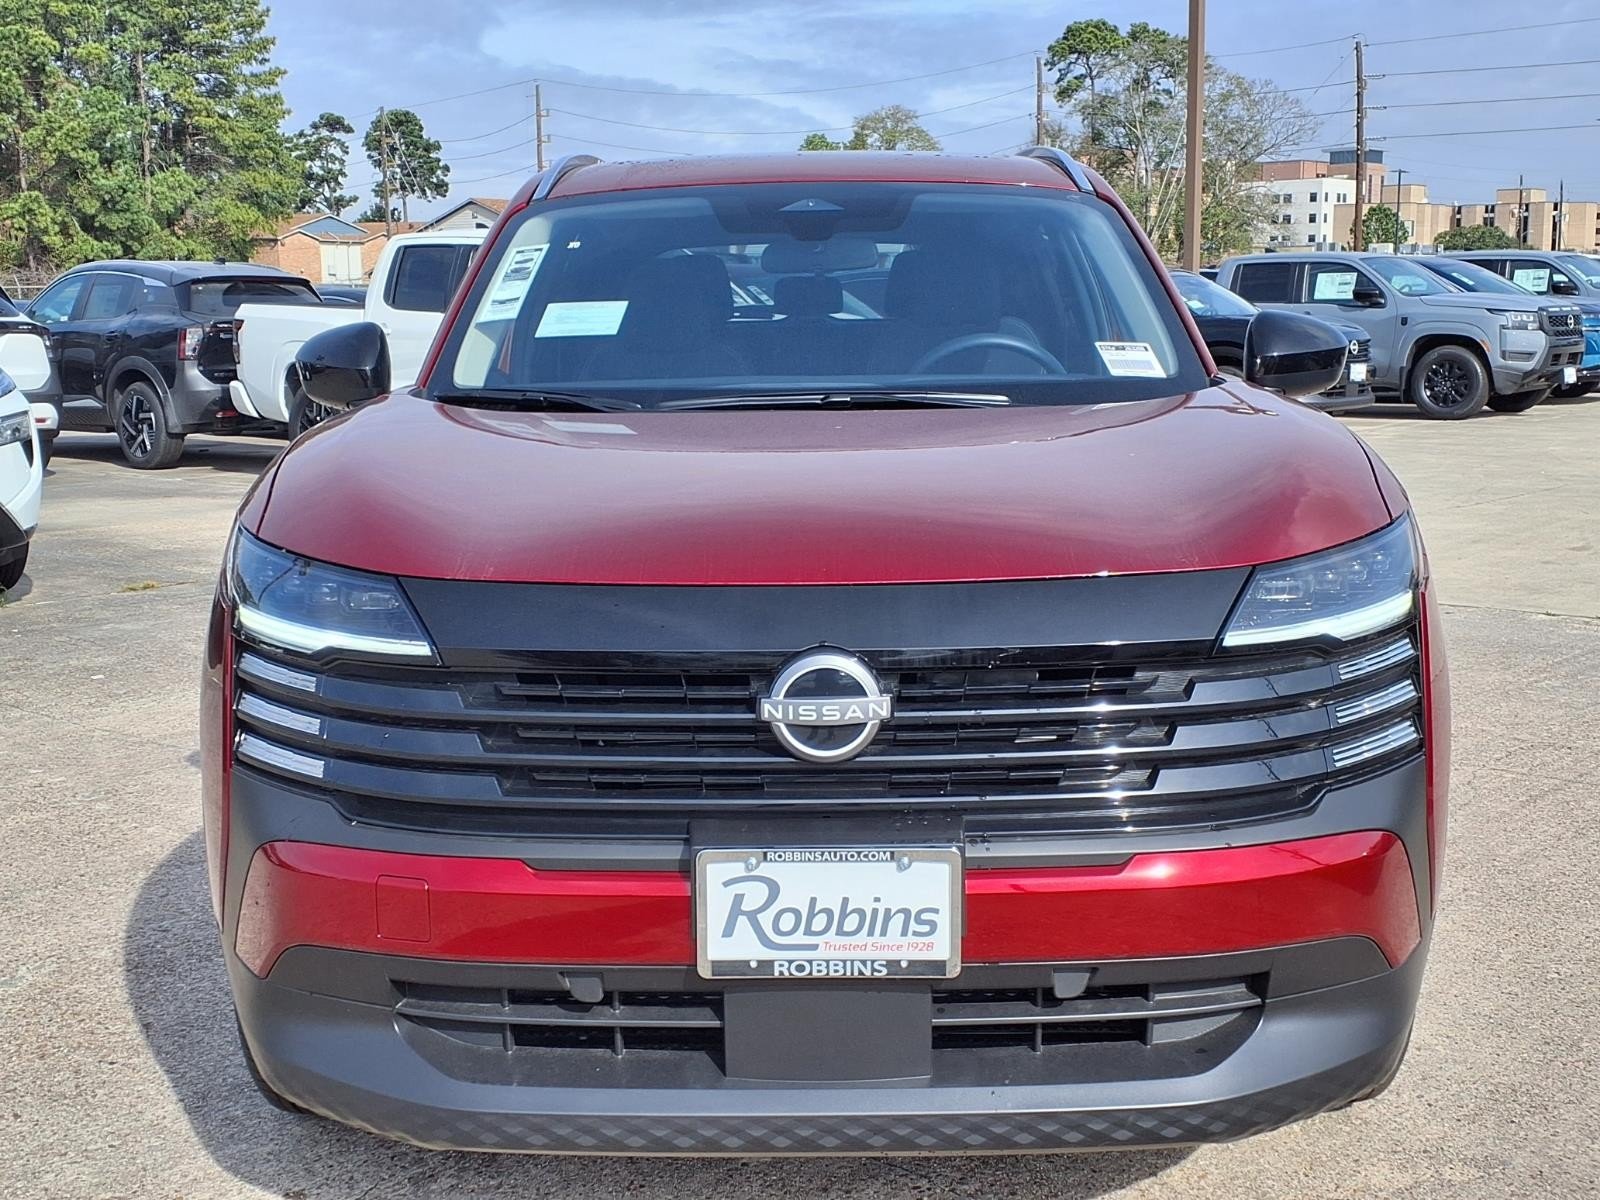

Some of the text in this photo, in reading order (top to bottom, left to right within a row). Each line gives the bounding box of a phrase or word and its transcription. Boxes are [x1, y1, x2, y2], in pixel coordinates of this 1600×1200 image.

[763, 701, 889, 721] NISSAN
[766, 851, 891, 862] ROBBINSAUTO.COM
[721, 874, 941, 952] Robbins
[823, 941, 935, 952] Trusted Since 1928
[773, 960, 888, 976] ROBBINS
